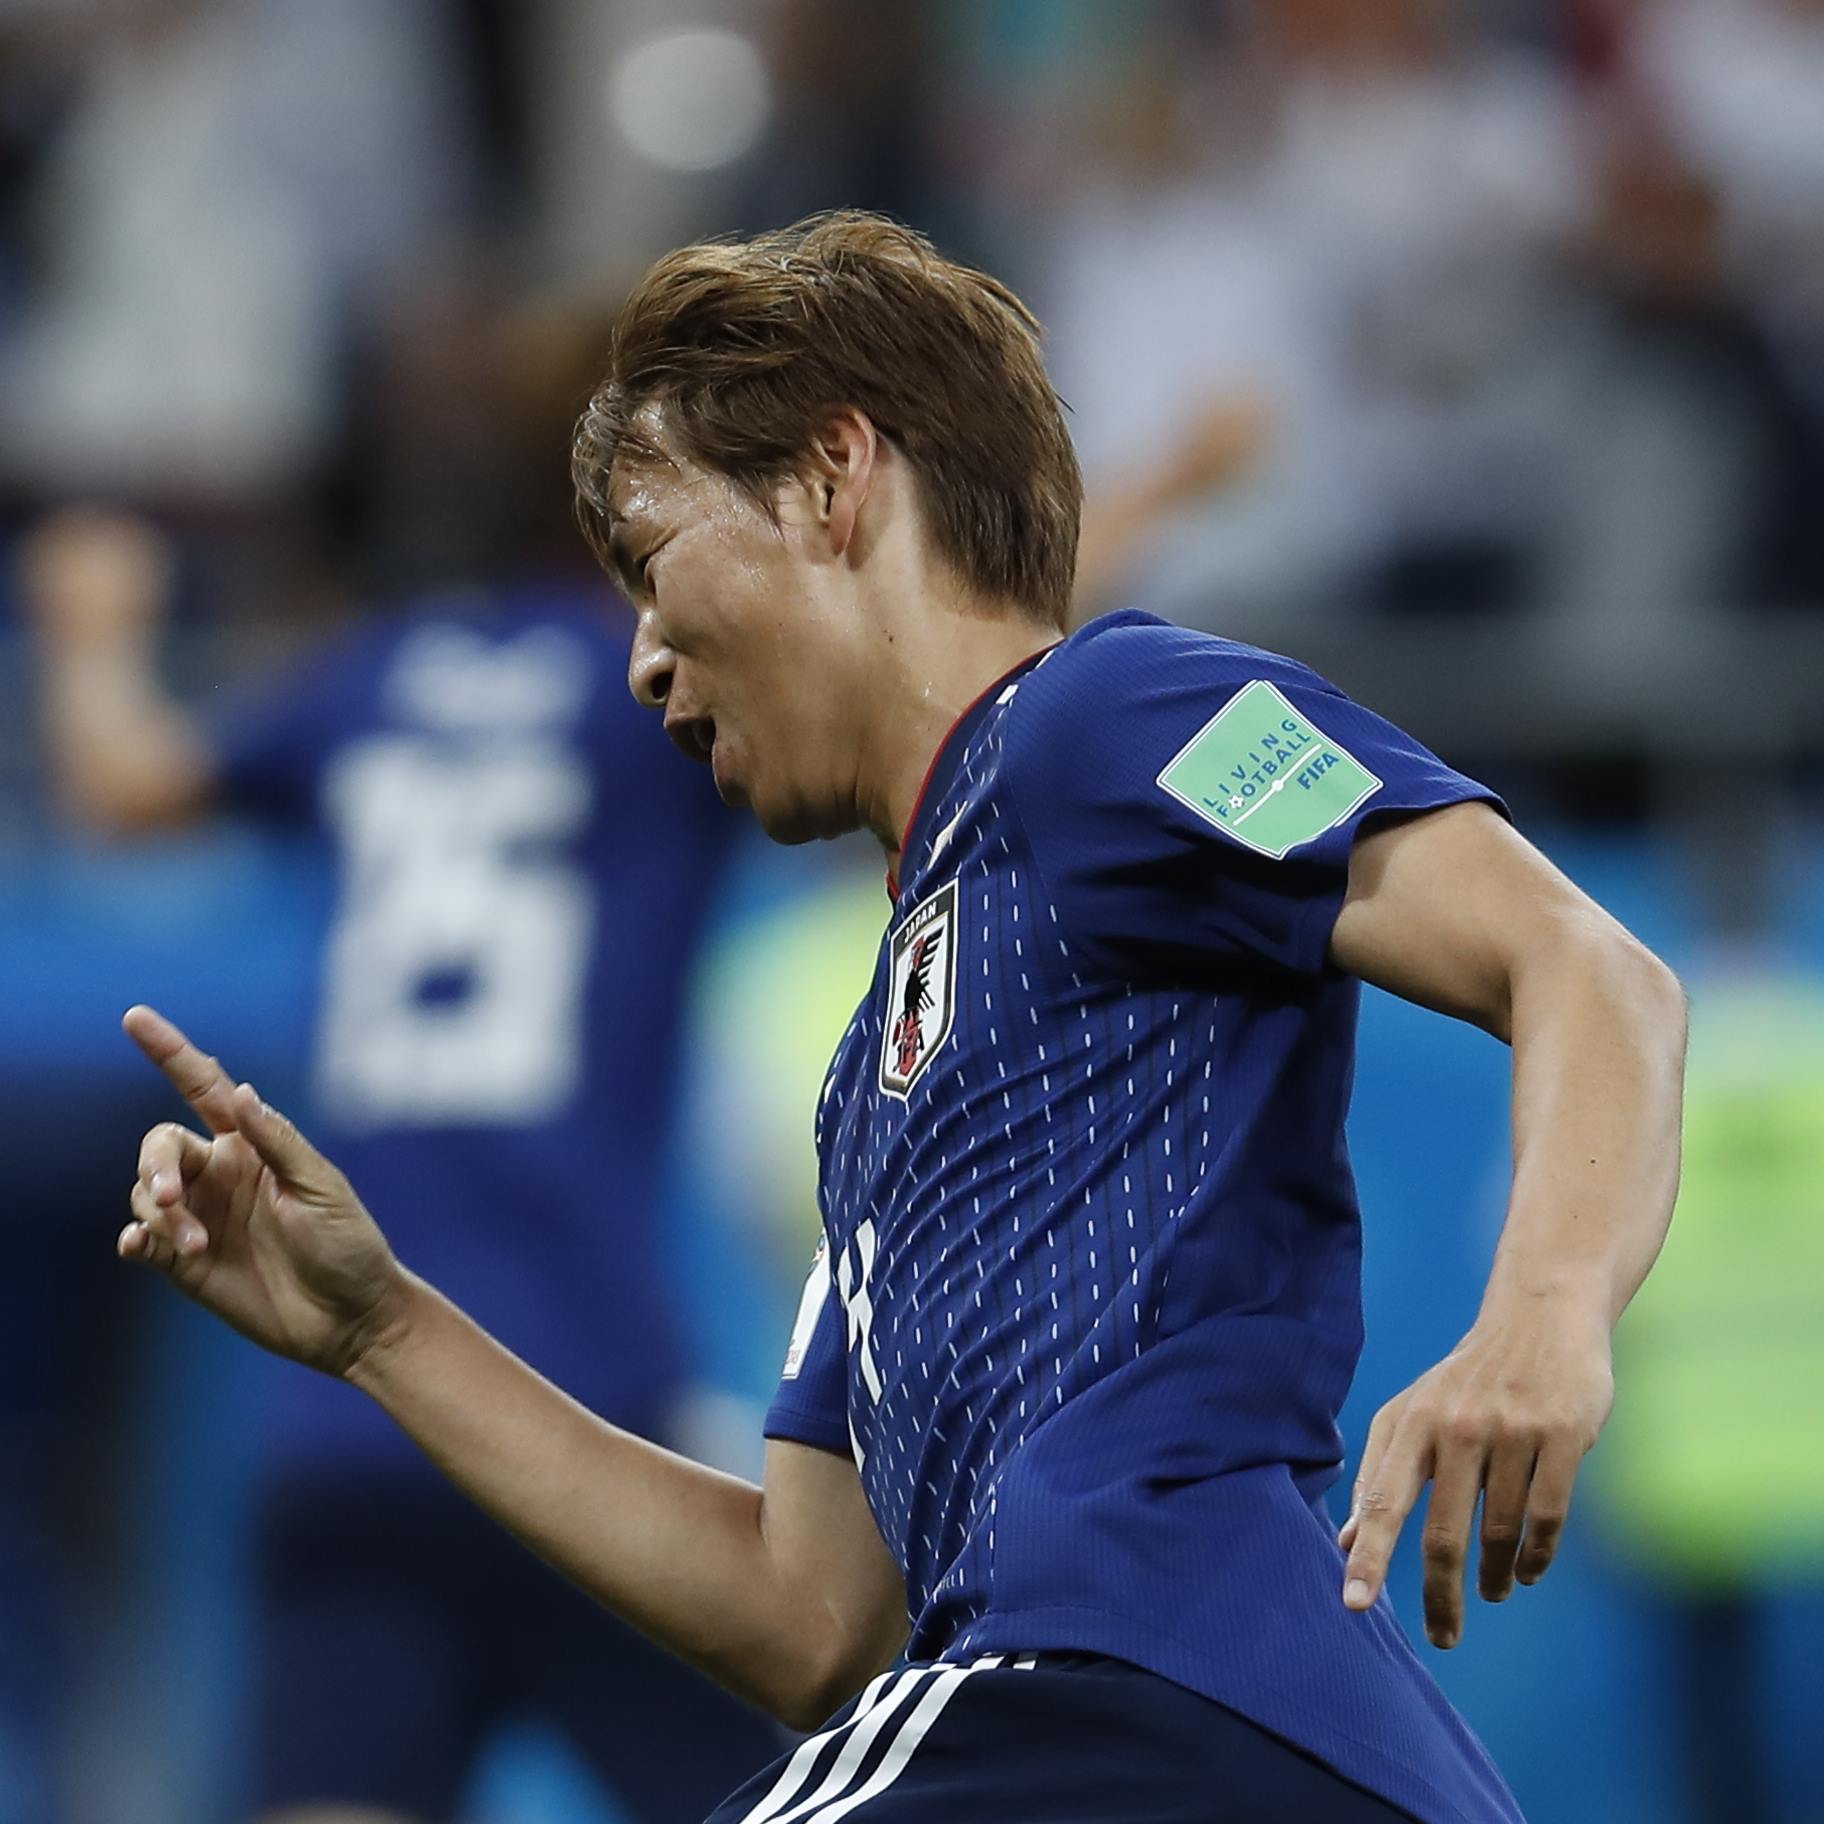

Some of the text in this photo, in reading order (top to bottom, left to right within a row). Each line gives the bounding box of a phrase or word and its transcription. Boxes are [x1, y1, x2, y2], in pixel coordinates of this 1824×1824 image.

[1203, 718, 1298, 808] LIVING
[1296, 751, 1340, 790] FIFA
[904, 901, 937, 943] JAPAN
